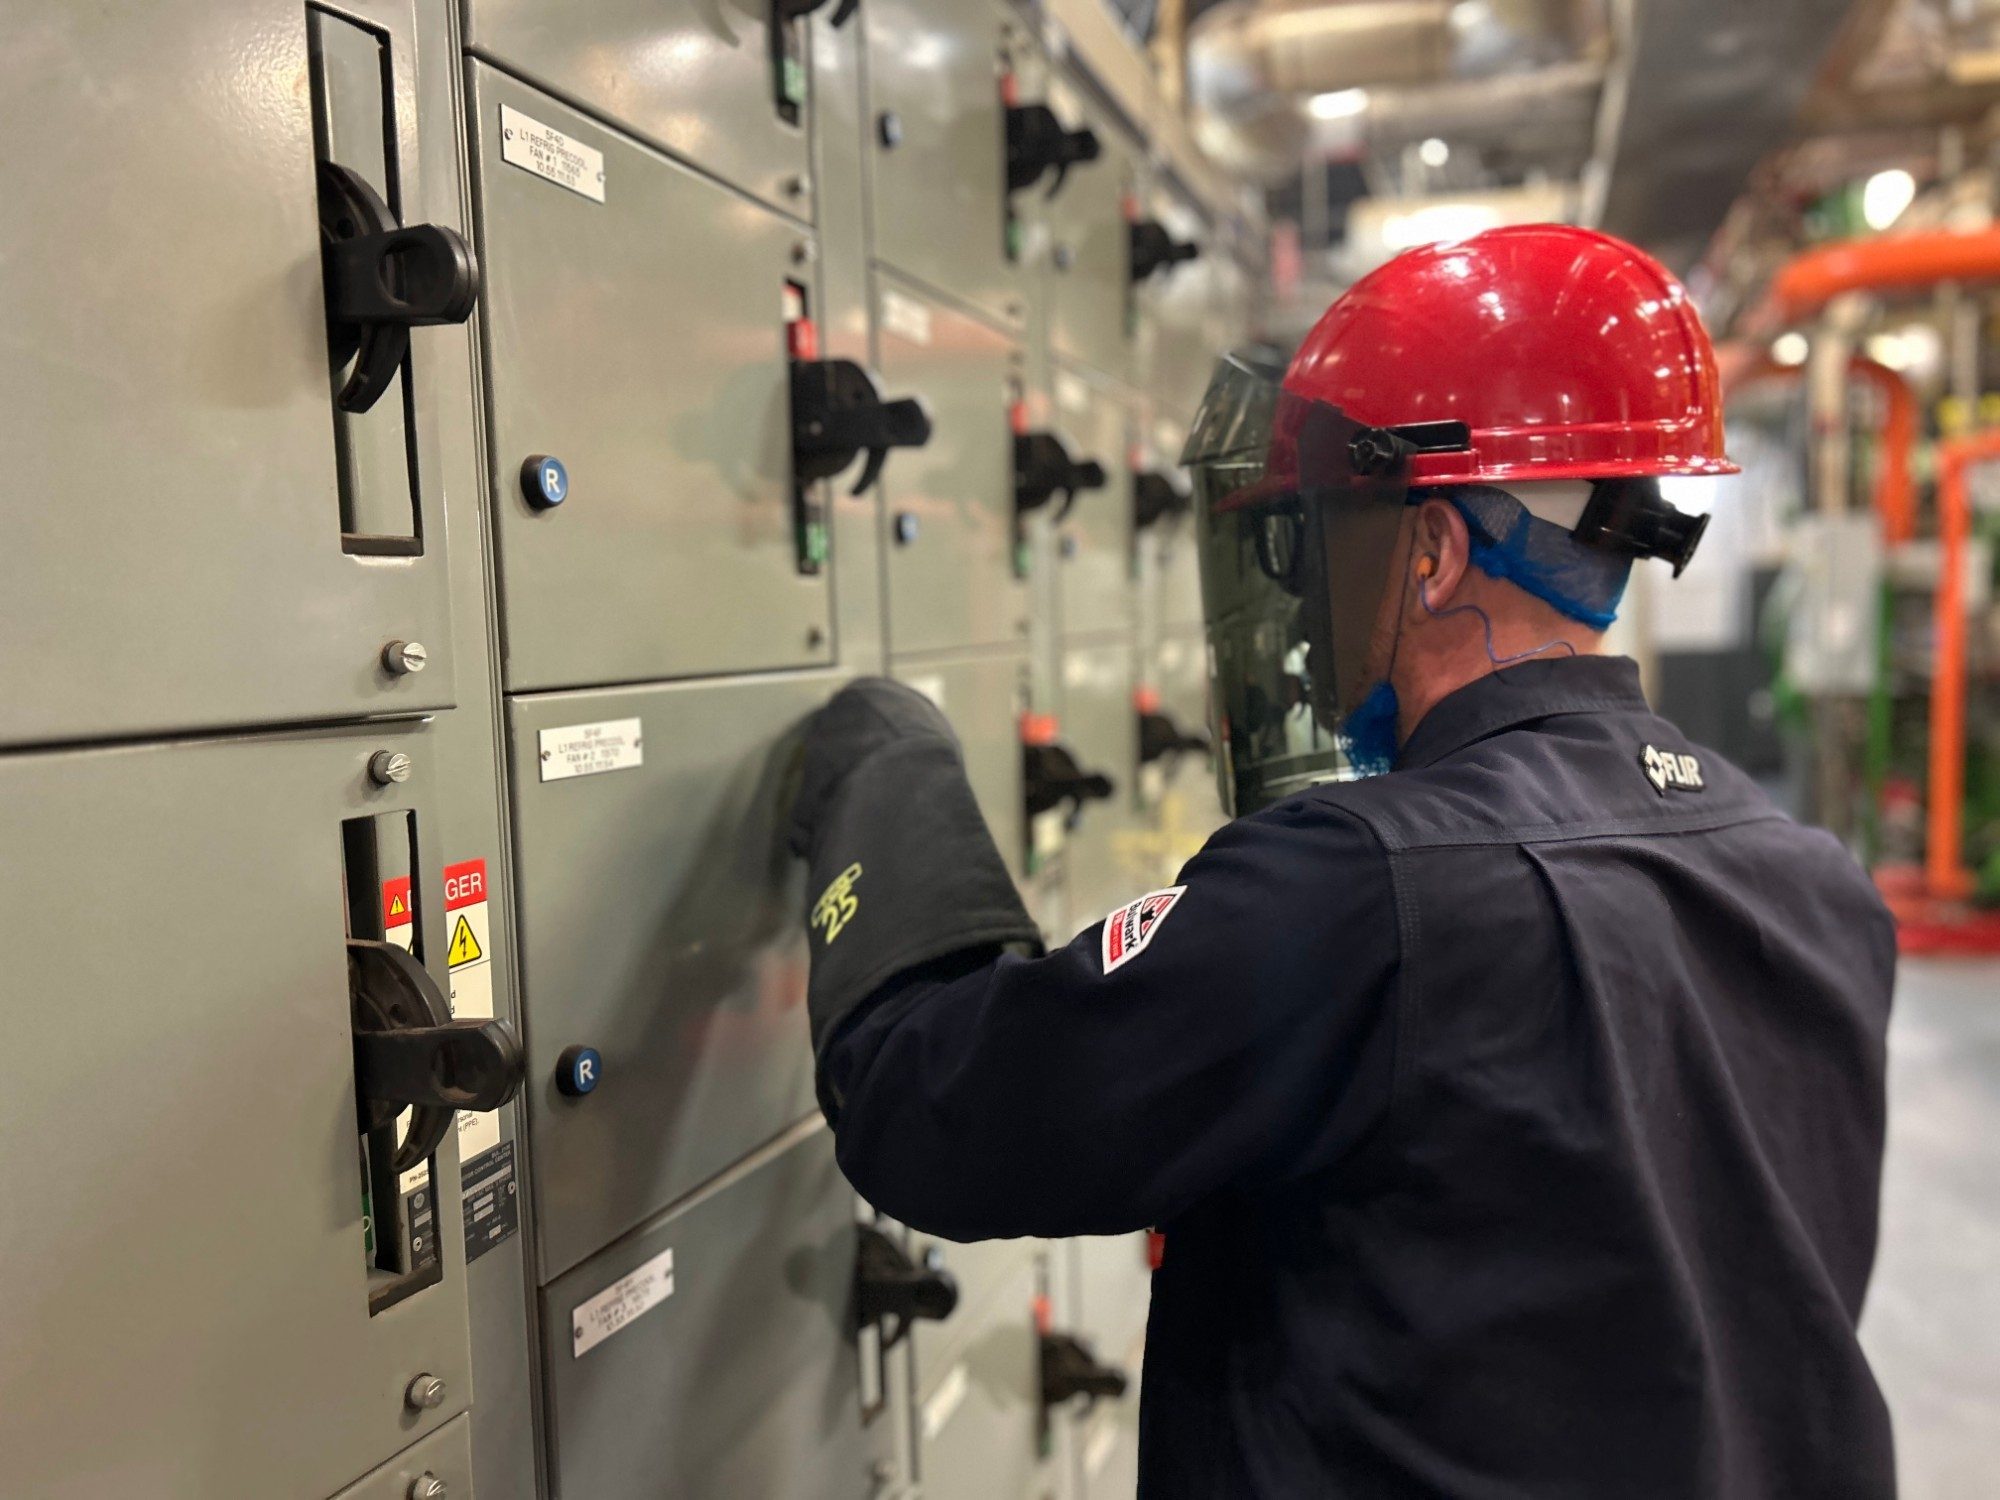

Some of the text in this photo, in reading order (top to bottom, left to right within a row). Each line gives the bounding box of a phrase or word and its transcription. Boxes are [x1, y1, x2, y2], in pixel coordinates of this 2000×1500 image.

[529, 145, 544, 160] FAN
[546, 468, 561, 493] R
[1660, 752, 1704, 786] FLIR
[445, 872, 483, 901] GER
[822, 886, 858, 945] 25
[579, 1058, 594, 1084] R
